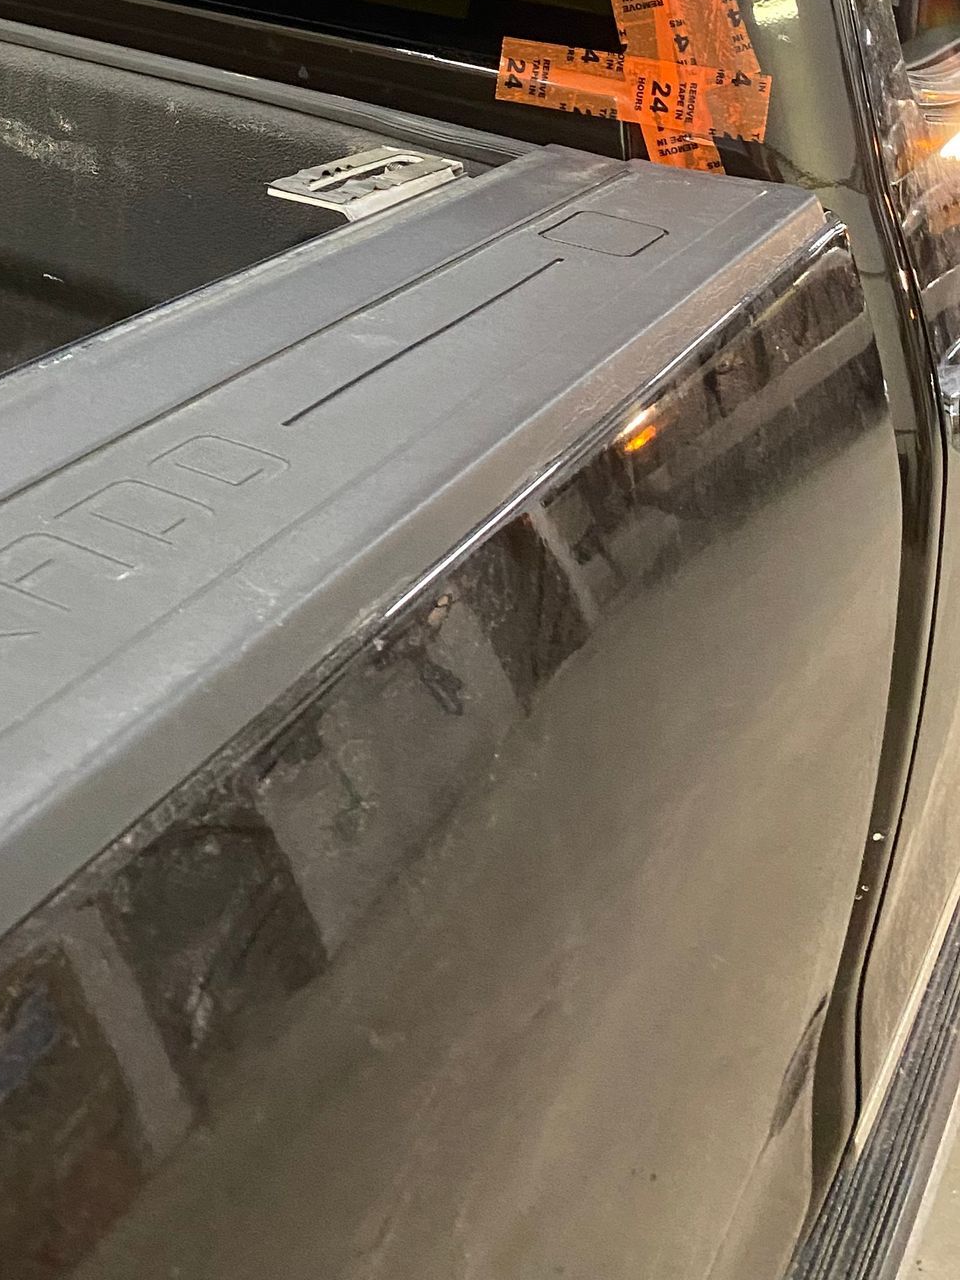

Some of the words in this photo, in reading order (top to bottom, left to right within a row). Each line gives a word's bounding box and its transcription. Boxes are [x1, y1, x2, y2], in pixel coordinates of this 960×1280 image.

[622, 0, 664, 13] REMOVE
[504, 57, 525, 89] 24
[529, 84, 537, 96] IN
[634, 77, 646, 112] HOURS
[649, 79, 671, 115] 24
[677, 82, 687, 106] TAPE
[684, 82, 698, 124] REMOVE
[675, 108, 683, 120] IN
[657, 138, 669, 146] IN
[658, 141, 699, 157] REMOVE
